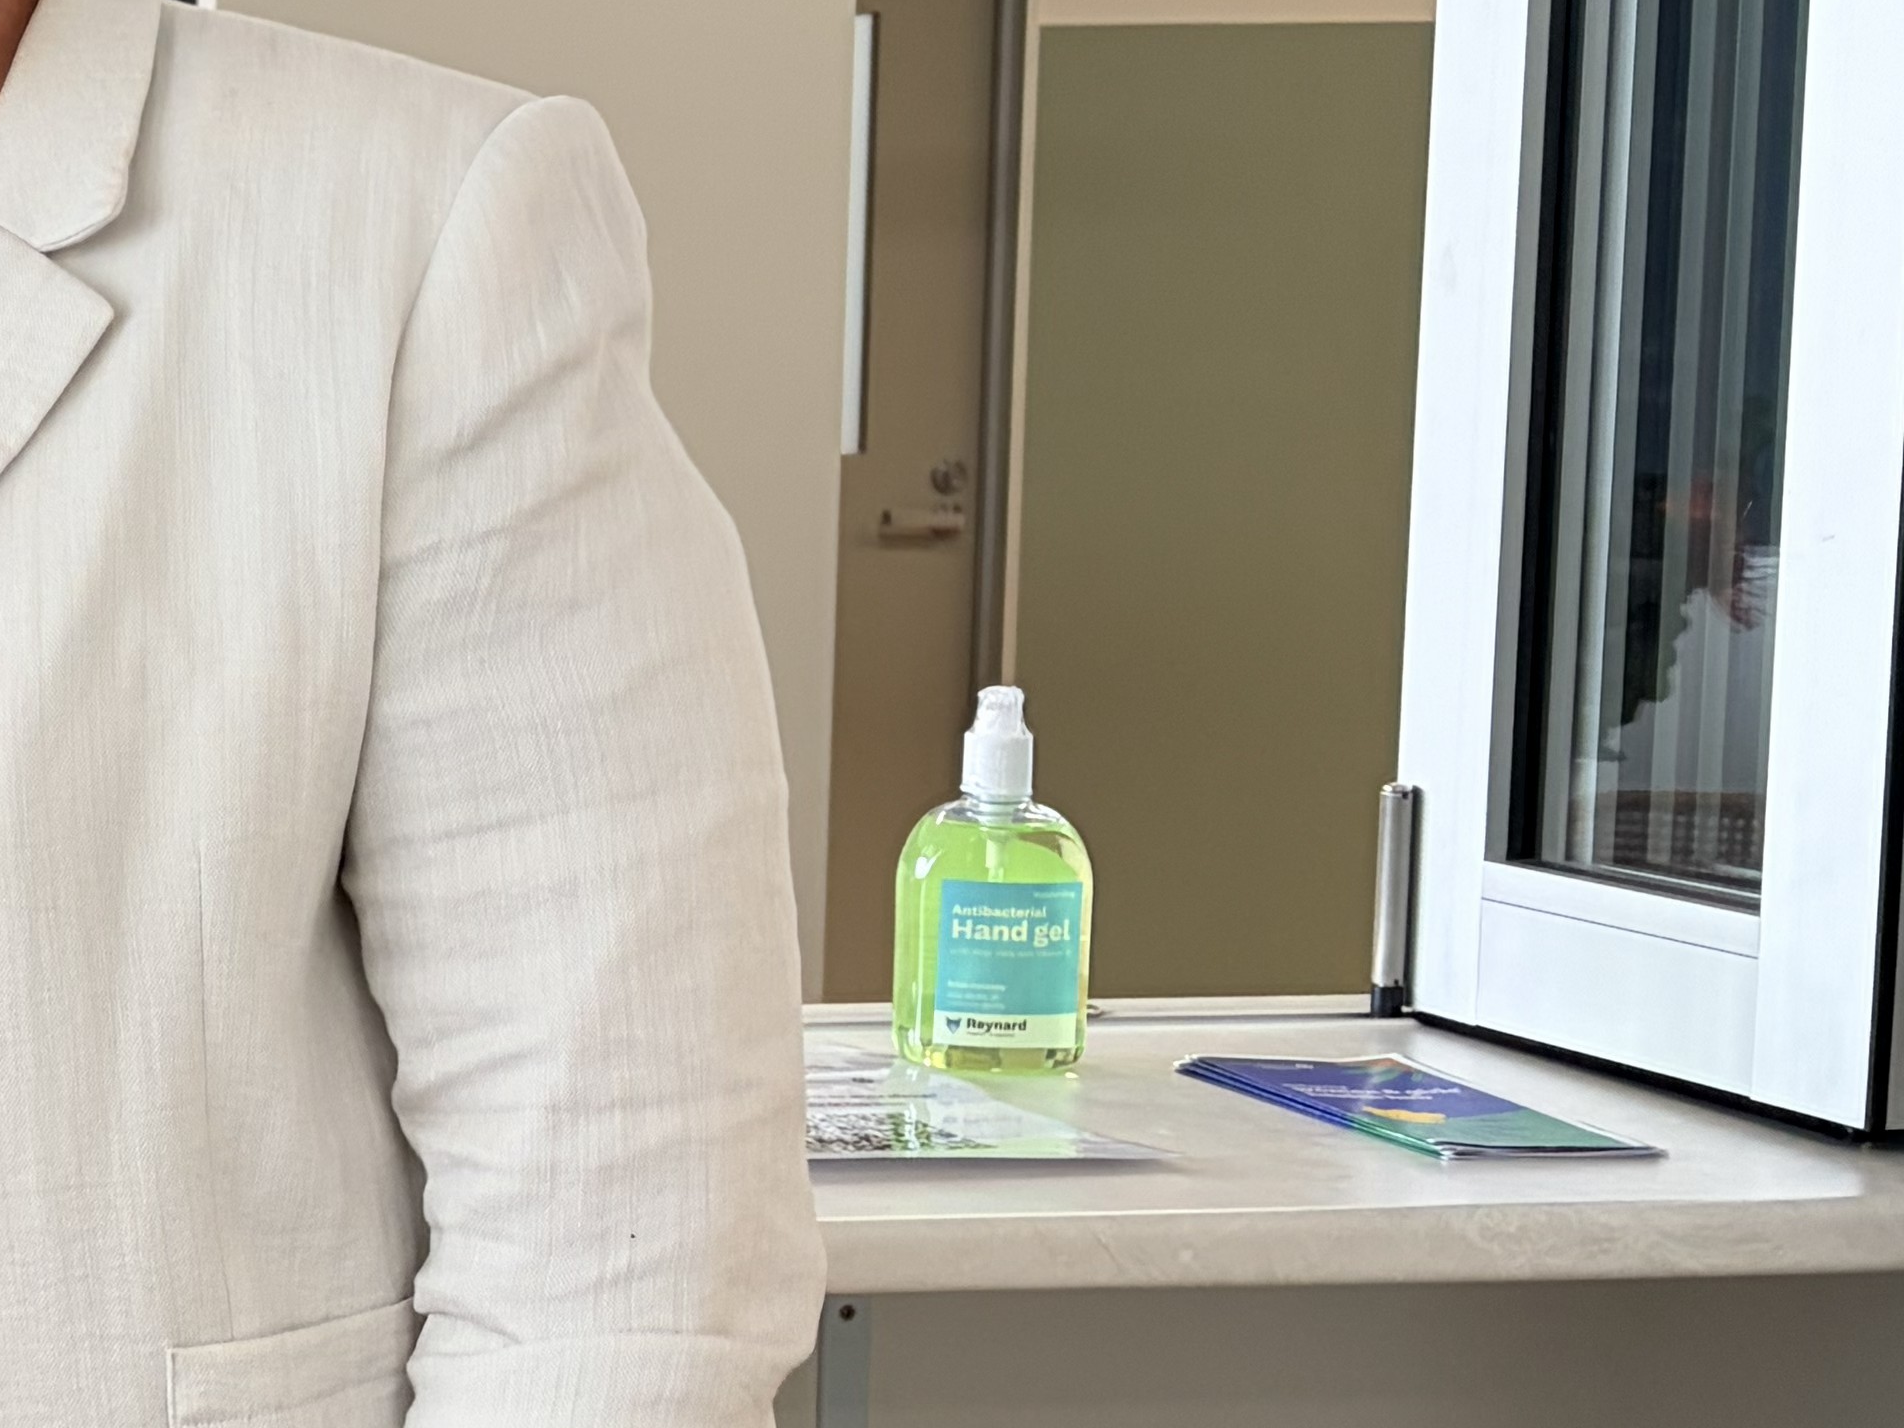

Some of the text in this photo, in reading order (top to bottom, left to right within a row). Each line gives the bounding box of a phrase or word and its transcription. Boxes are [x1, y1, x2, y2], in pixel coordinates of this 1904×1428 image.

[952, 904, 1047, 918] Antibacterial
[951, 919, 1071, 948] Hand gel
